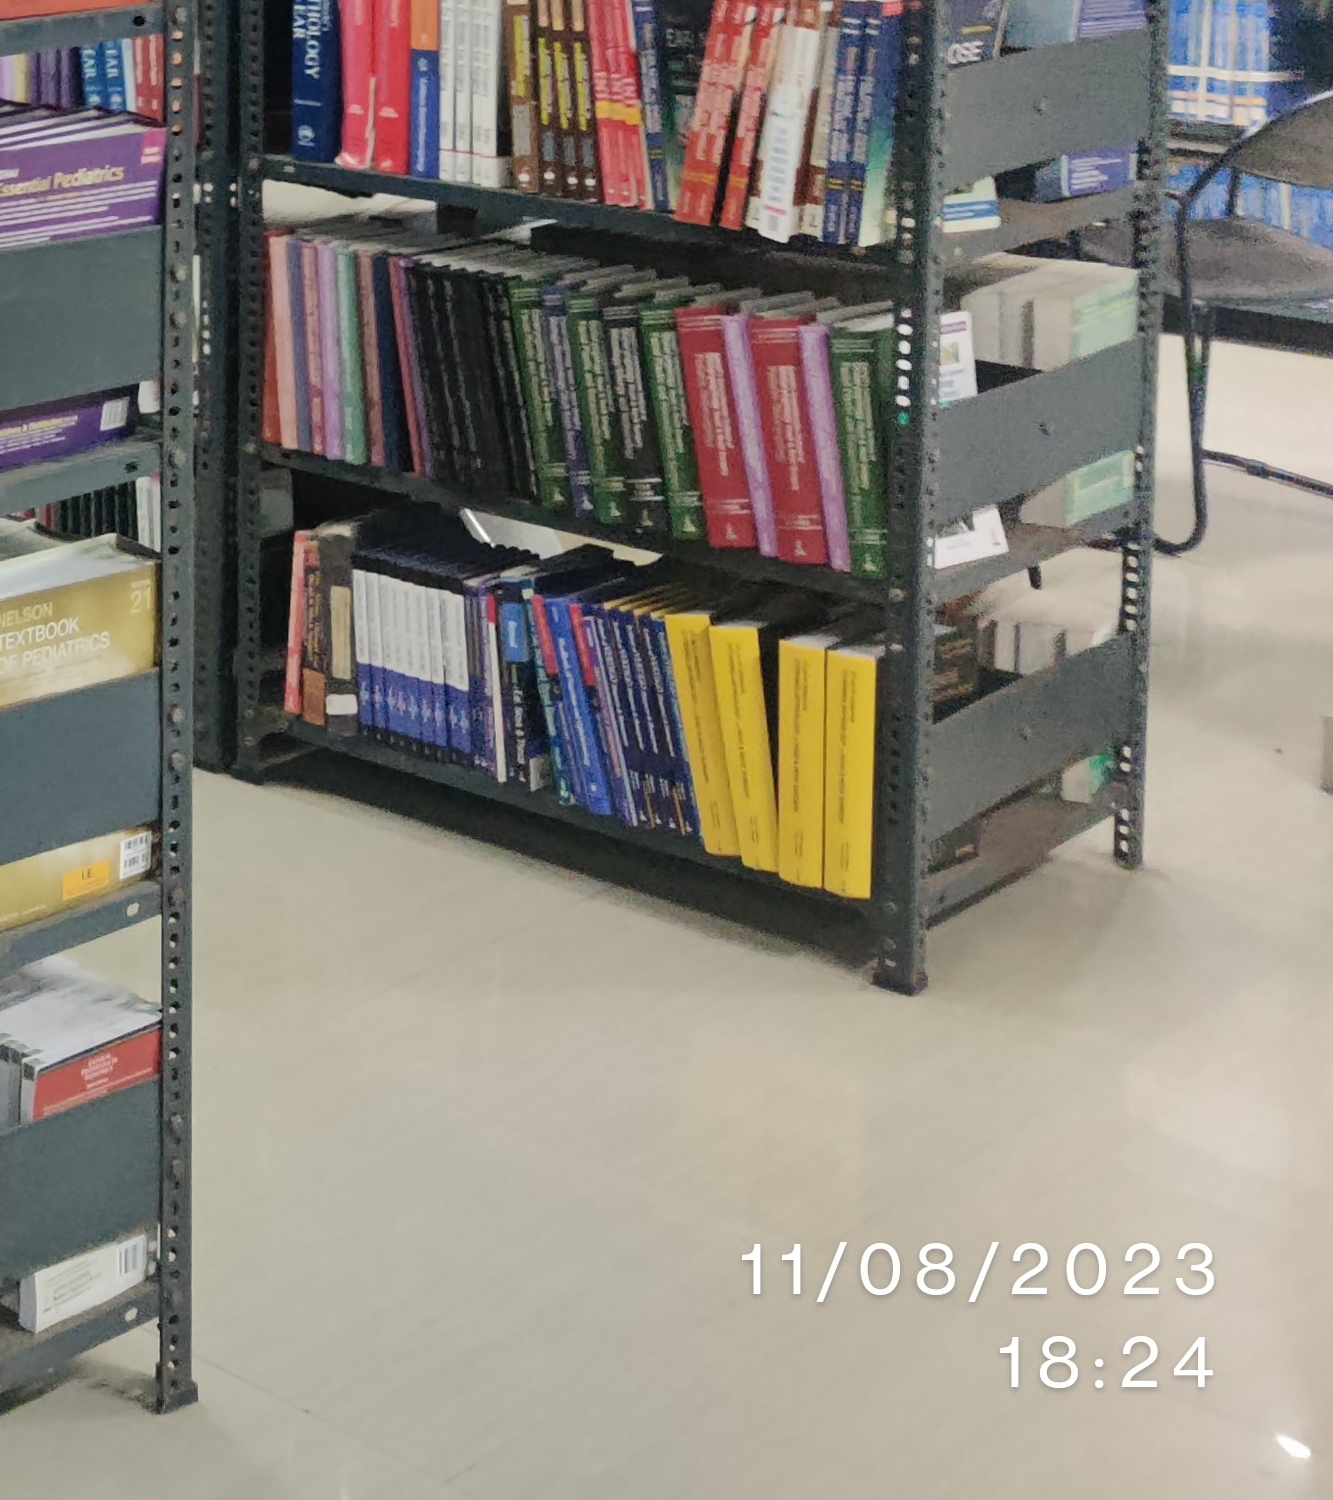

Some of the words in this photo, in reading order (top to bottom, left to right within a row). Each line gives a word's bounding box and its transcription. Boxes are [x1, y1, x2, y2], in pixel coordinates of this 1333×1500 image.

[53, 165, 126, 190] Pediatrics
[130, 585, 152, 614] 21
[22, 631, 111, 669] PEDIATRICS
